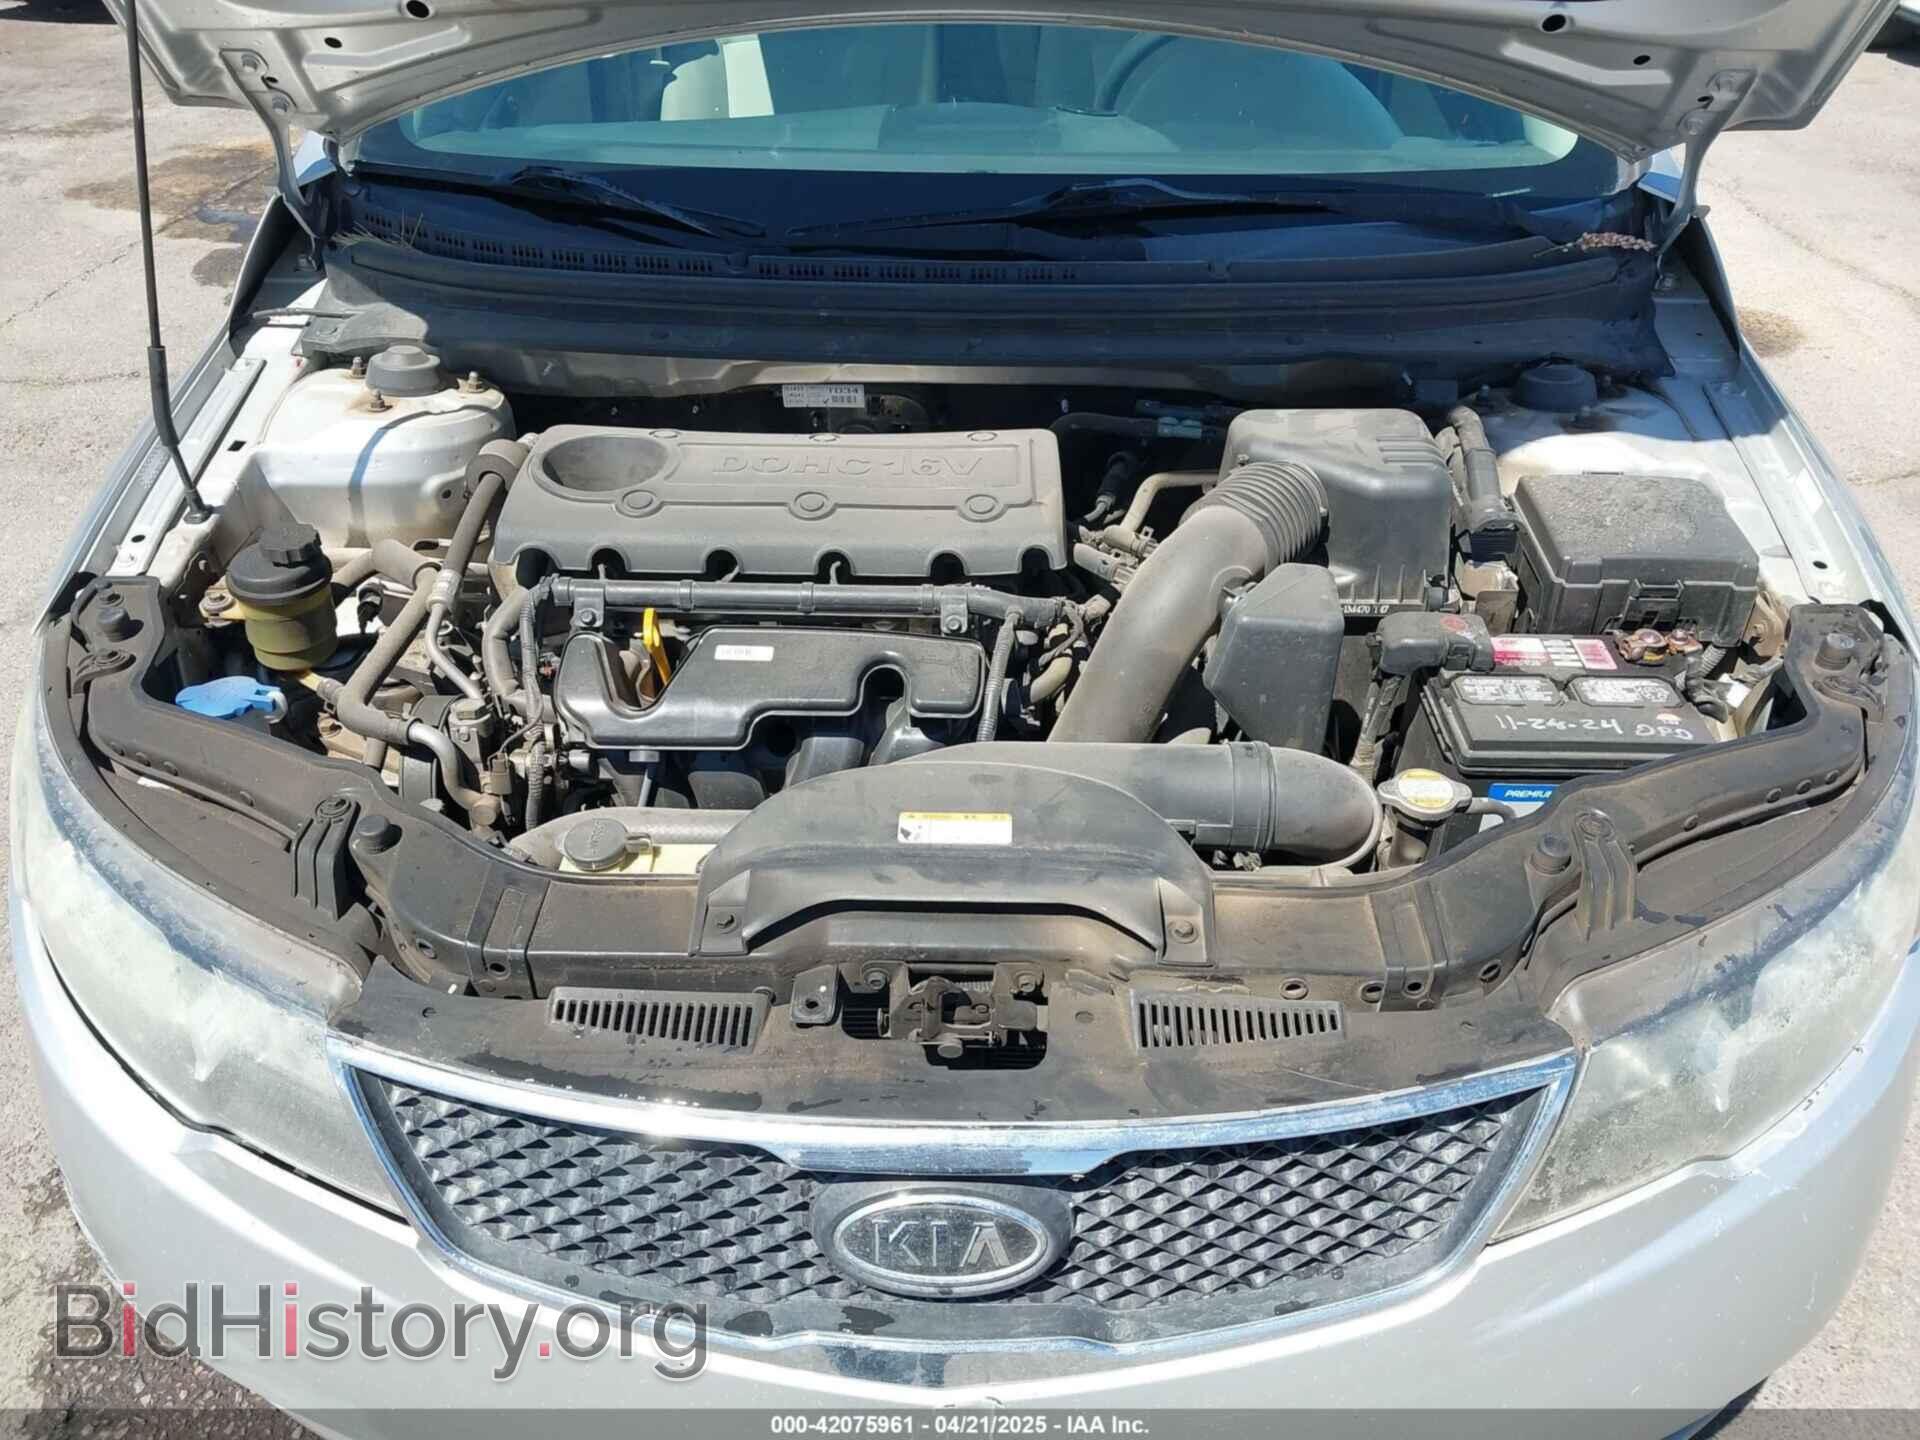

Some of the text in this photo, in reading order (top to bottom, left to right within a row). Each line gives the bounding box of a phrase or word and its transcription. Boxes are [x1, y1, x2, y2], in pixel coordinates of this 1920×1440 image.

[713, 455, 984, 475] DOHC 16V
[871, 1219, 1011, 1267] KIA
